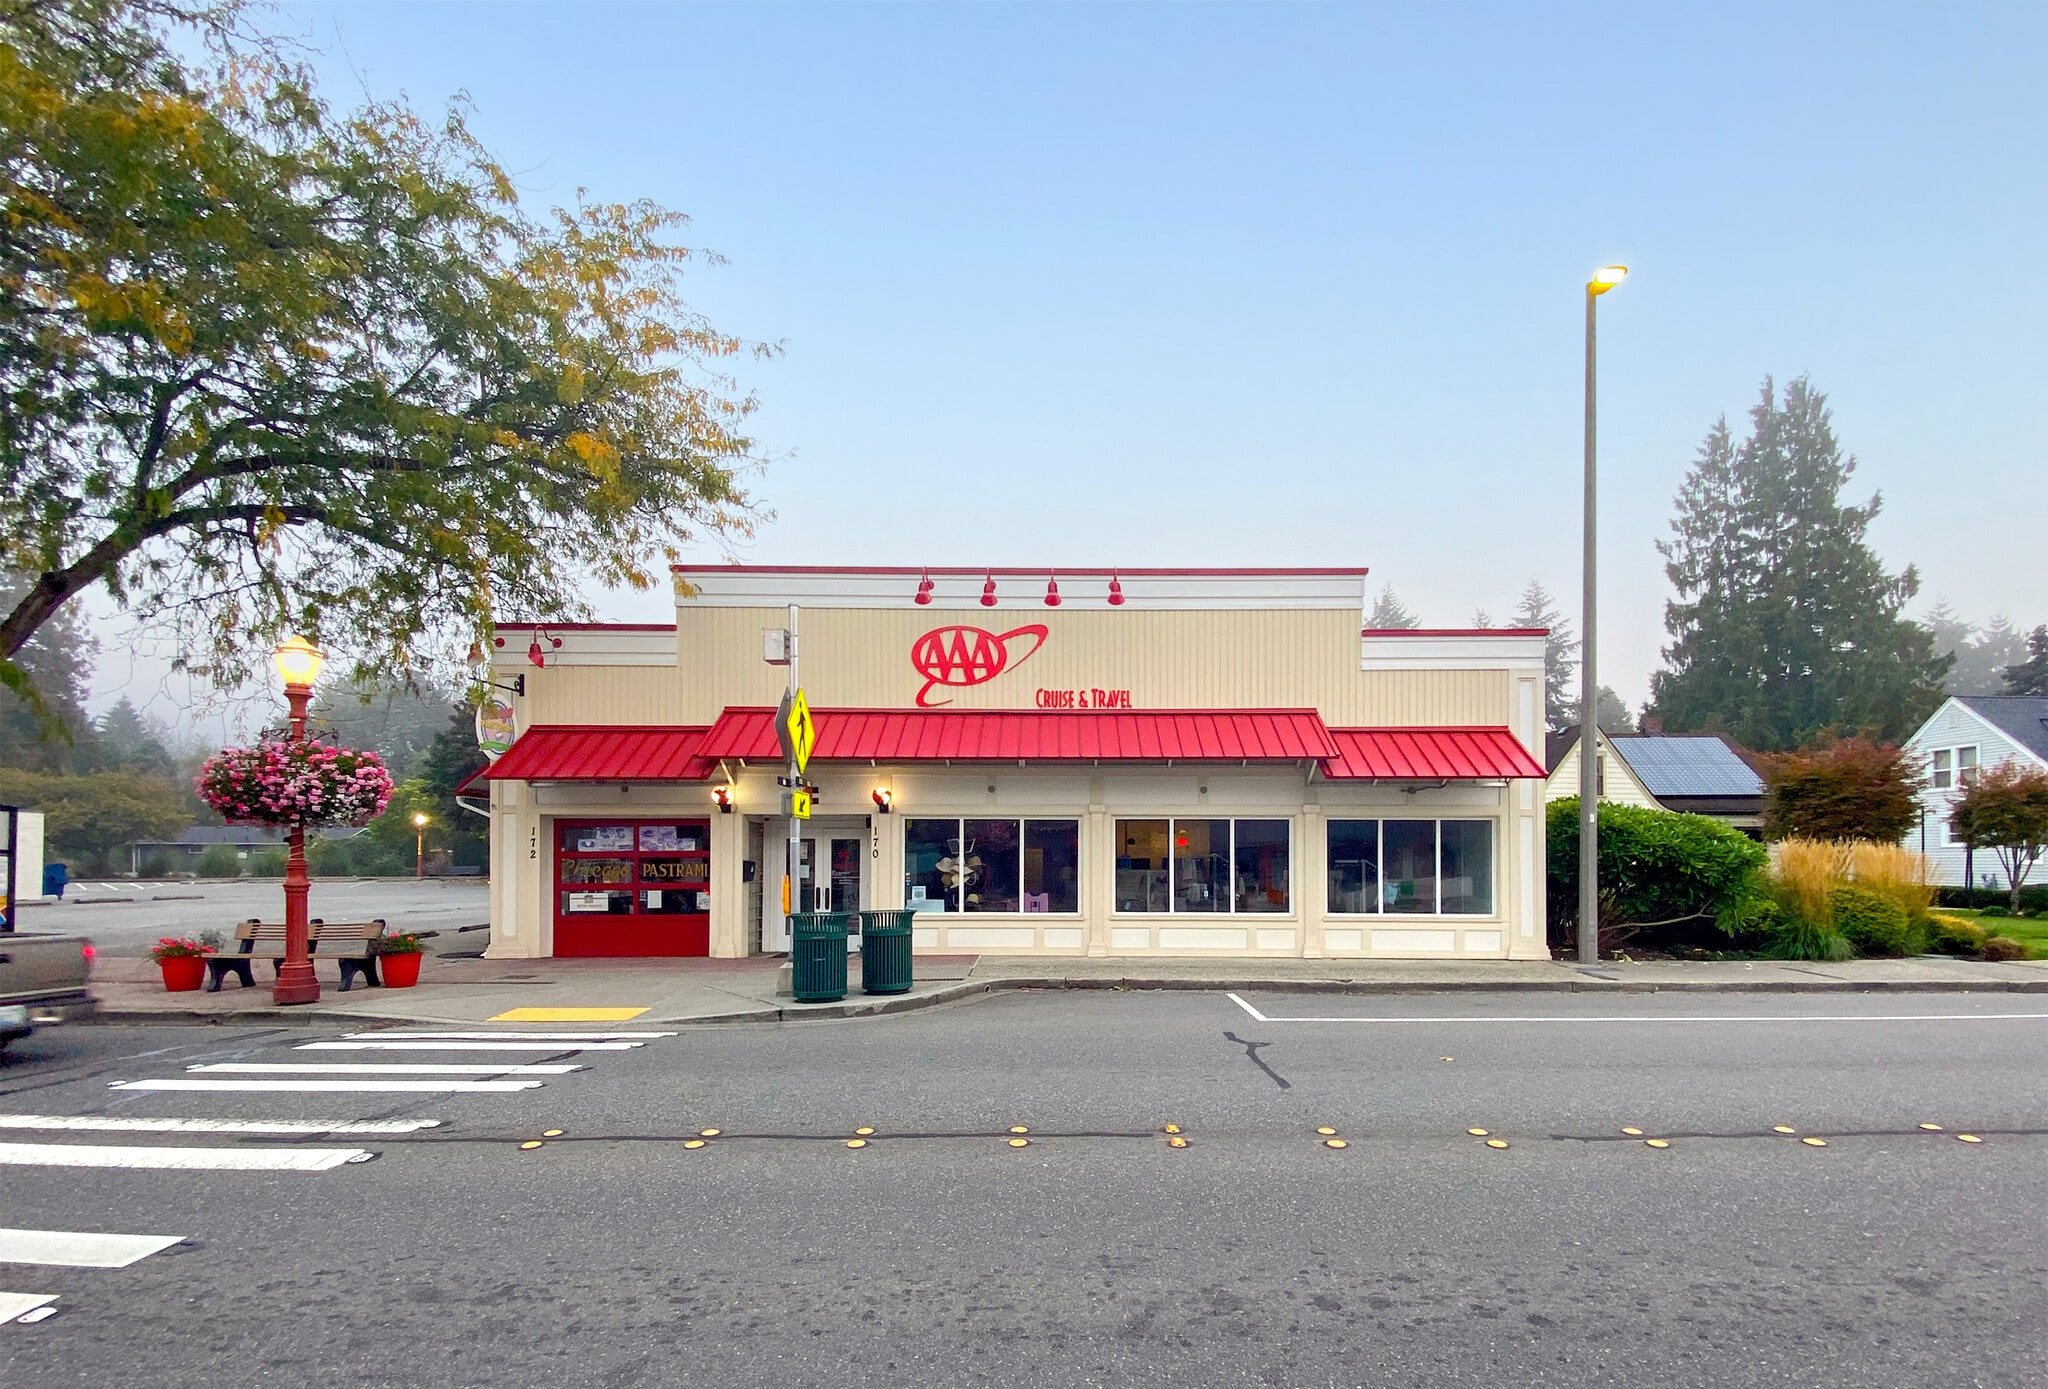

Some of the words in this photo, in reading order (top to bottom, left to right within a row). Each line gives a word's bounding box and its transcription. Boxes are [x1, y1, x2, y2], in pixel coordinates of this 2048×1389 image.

[922, 628, 996, 684] AAA
[1079, 689, 1088, 708] &
[562, 860, 630, 881] Chicago
[643, 863, 708, 877] PASTRAMI
